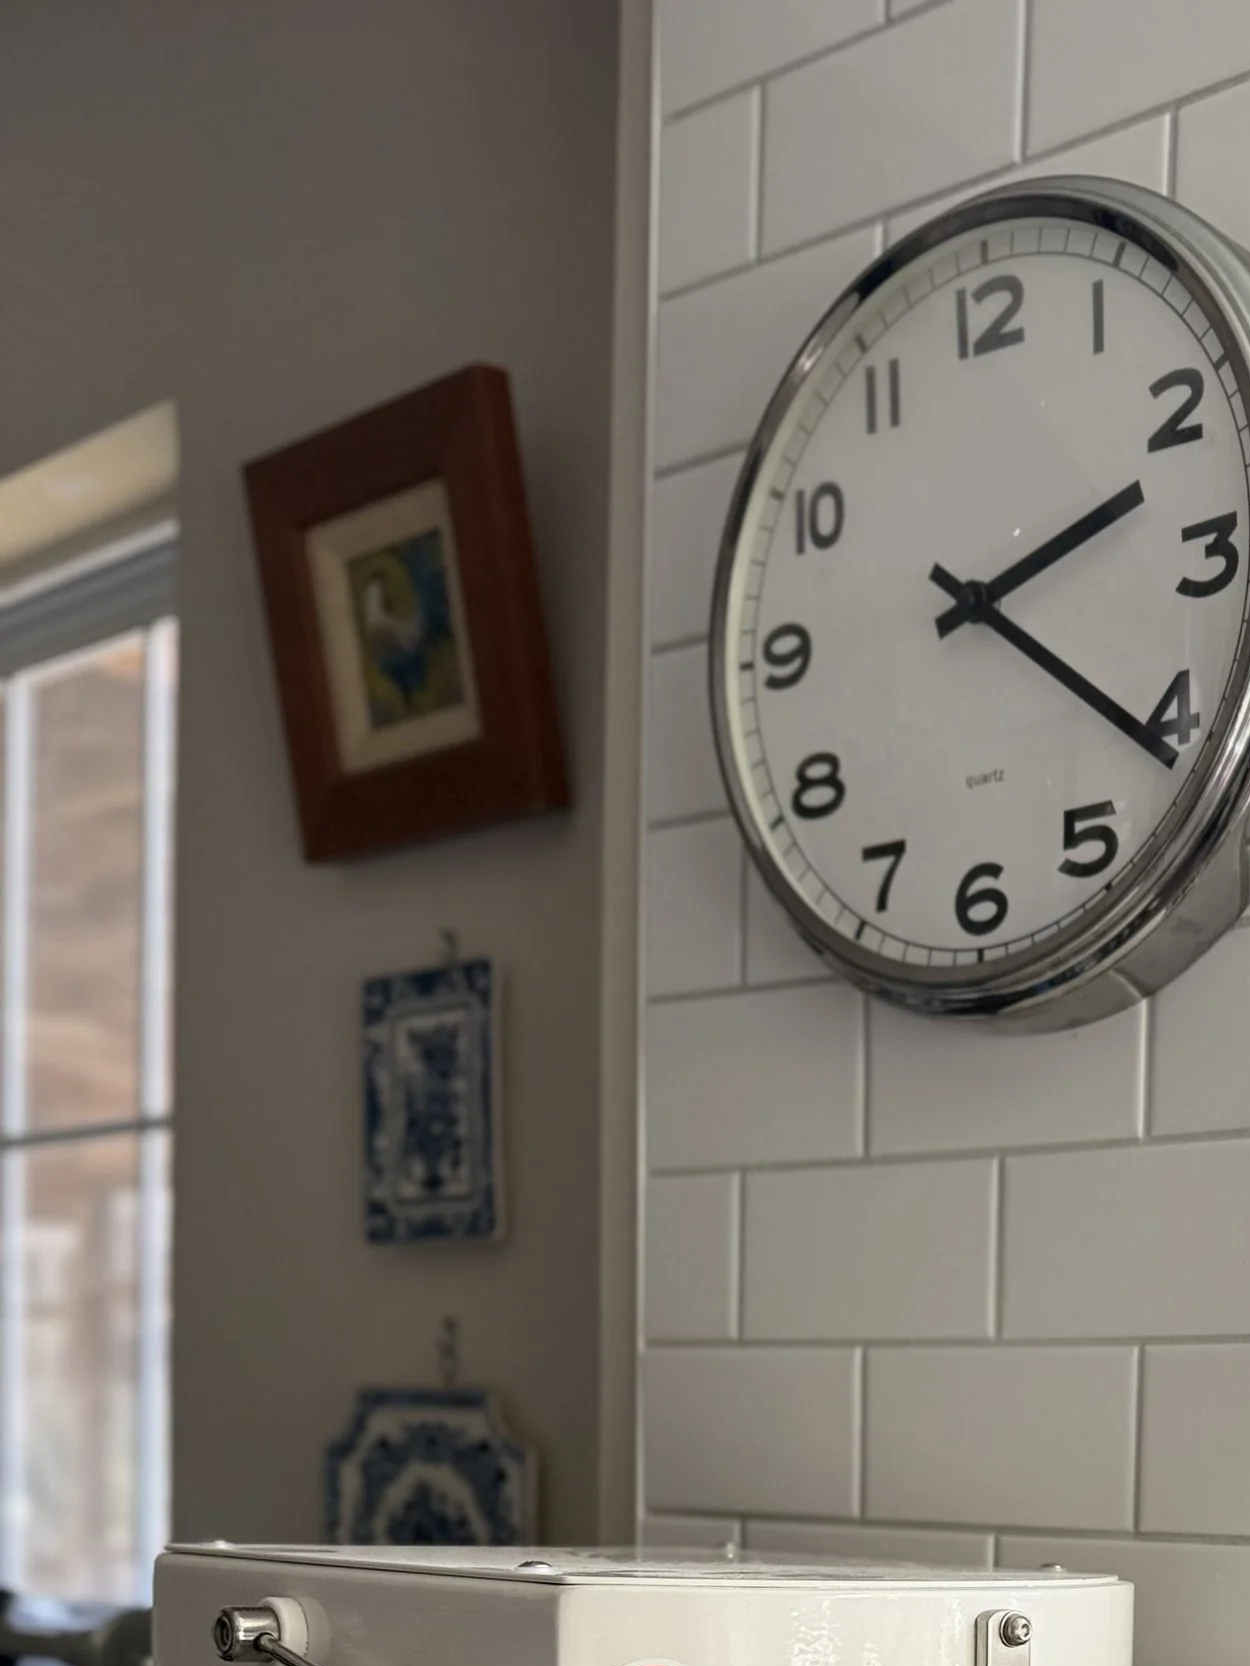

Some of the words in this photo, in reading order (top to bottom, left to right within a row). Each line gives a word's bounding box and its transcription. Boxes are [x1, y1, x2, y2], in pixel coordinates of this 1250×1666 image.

[955, 273, 1026, 361] 12
[1091, 279, 1105, 355] 1
[864, 358, 902, 435] 11
[1147, 367, 1206, 453] 2
[794, 481, 846, 556] 10
[1175, 511, 1240, 598] 3
[762, 623, 812, 691] 9
[1143, 669, 1201, 746] 4
[791, 751, 847, 819] 8
[965, 768, 1005, 790] quartz
[862, 839, 907, 913] 7
[1057, 799, 1120, 879] 5
[953, 861, 1010, 937] 6
